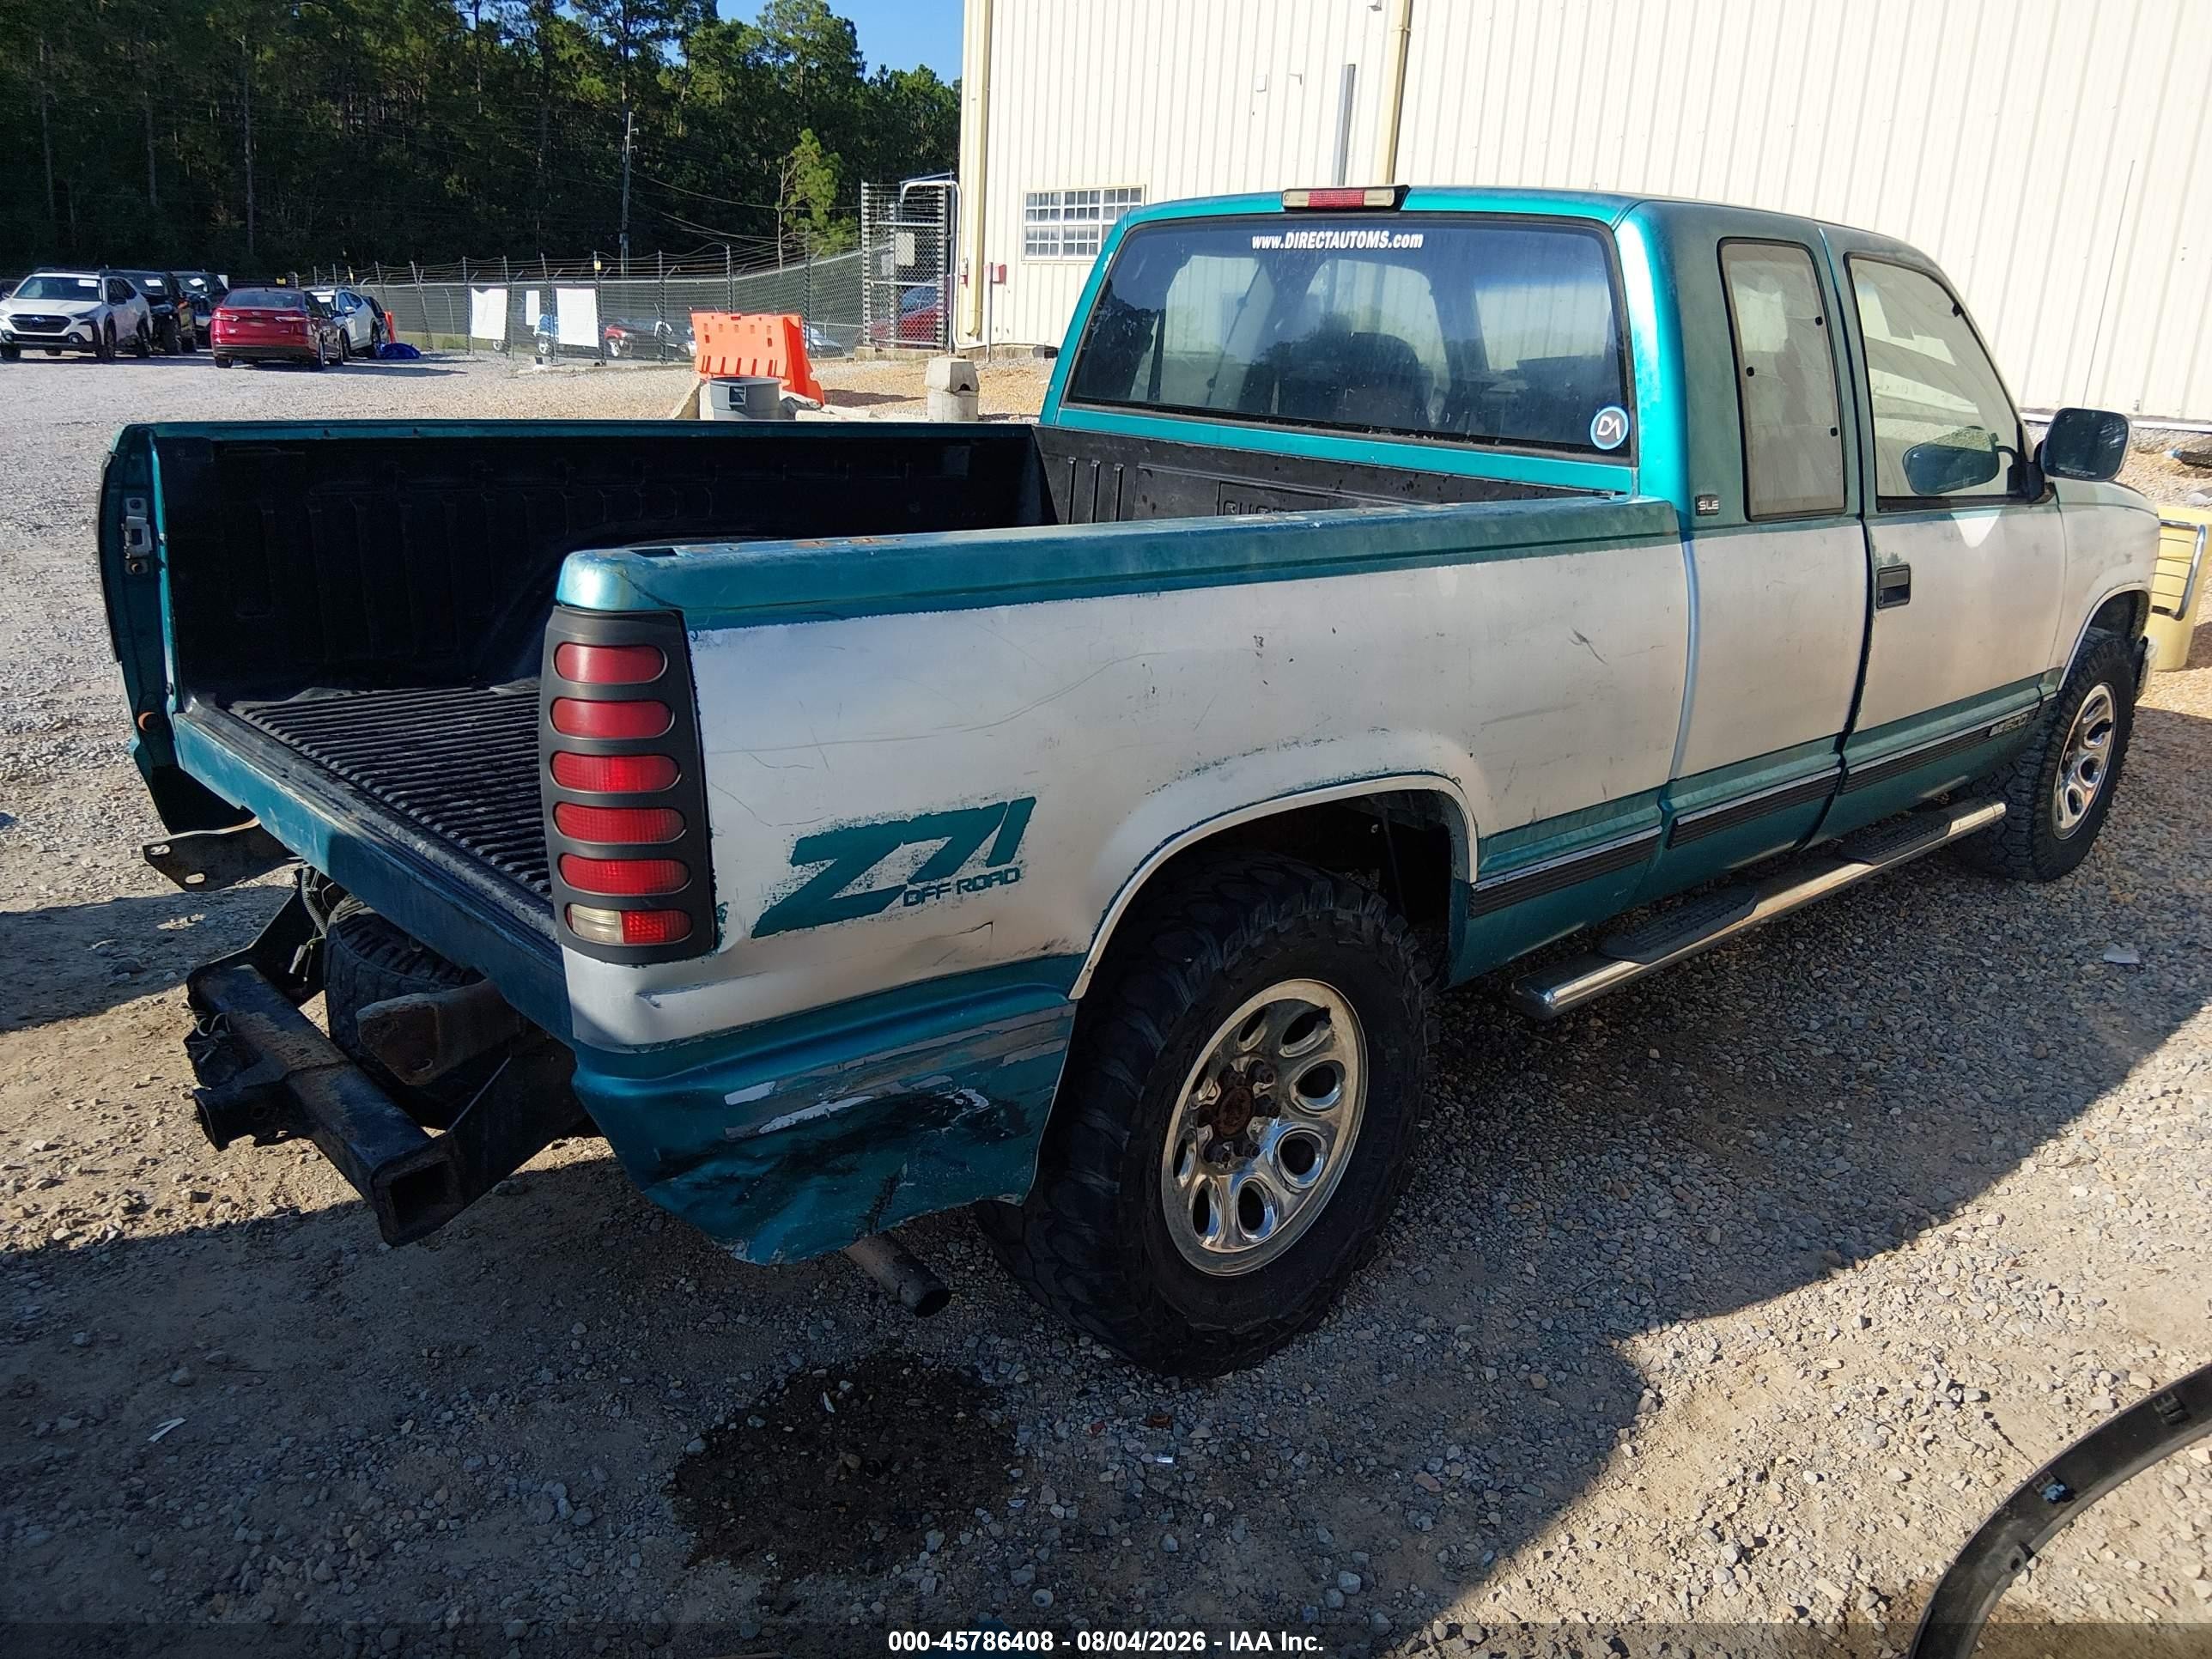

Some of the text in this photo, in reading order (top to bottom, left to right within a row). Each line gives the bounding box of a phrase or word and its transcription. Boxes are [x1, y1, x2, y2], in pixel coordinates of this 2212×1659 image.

[1252, 230, 1424, 249] www.DIRECTAUTOMS.com
[1698, 500, 1719, 511] SLE
[750, 796, 1037, 939] Z71
[903, 867, 1021, 908] OFF ROAD
